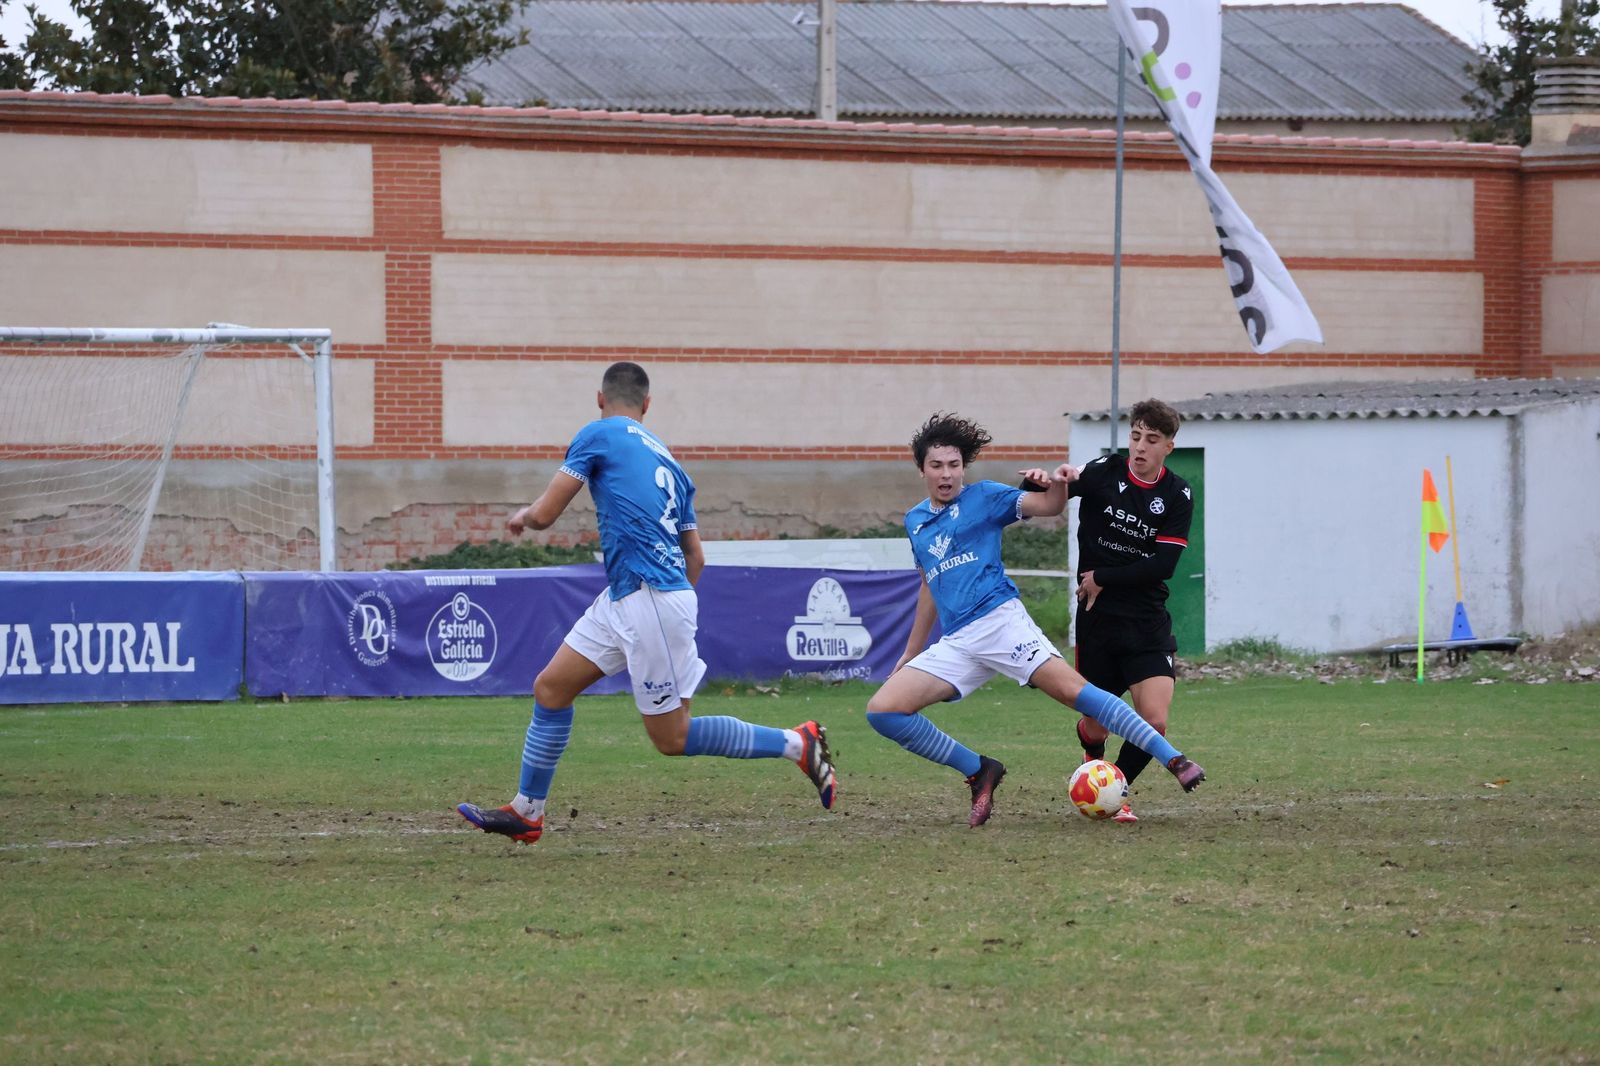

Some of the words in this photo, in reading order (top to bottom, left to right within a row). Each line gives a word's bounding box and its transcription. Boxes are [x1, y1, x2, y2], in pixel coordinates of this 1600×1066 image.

[655, 465, 679, 535] 2
[1103, 505, 1158, 537] ASPIRE
[939, 551, 979, 573] RURAL
[438, 618, 485, 638] Estrella
[50, 622, 195, 675] RURAL
[441, 639, 483, 660] Galicia
[795, 630, 849, 657] Revilla
